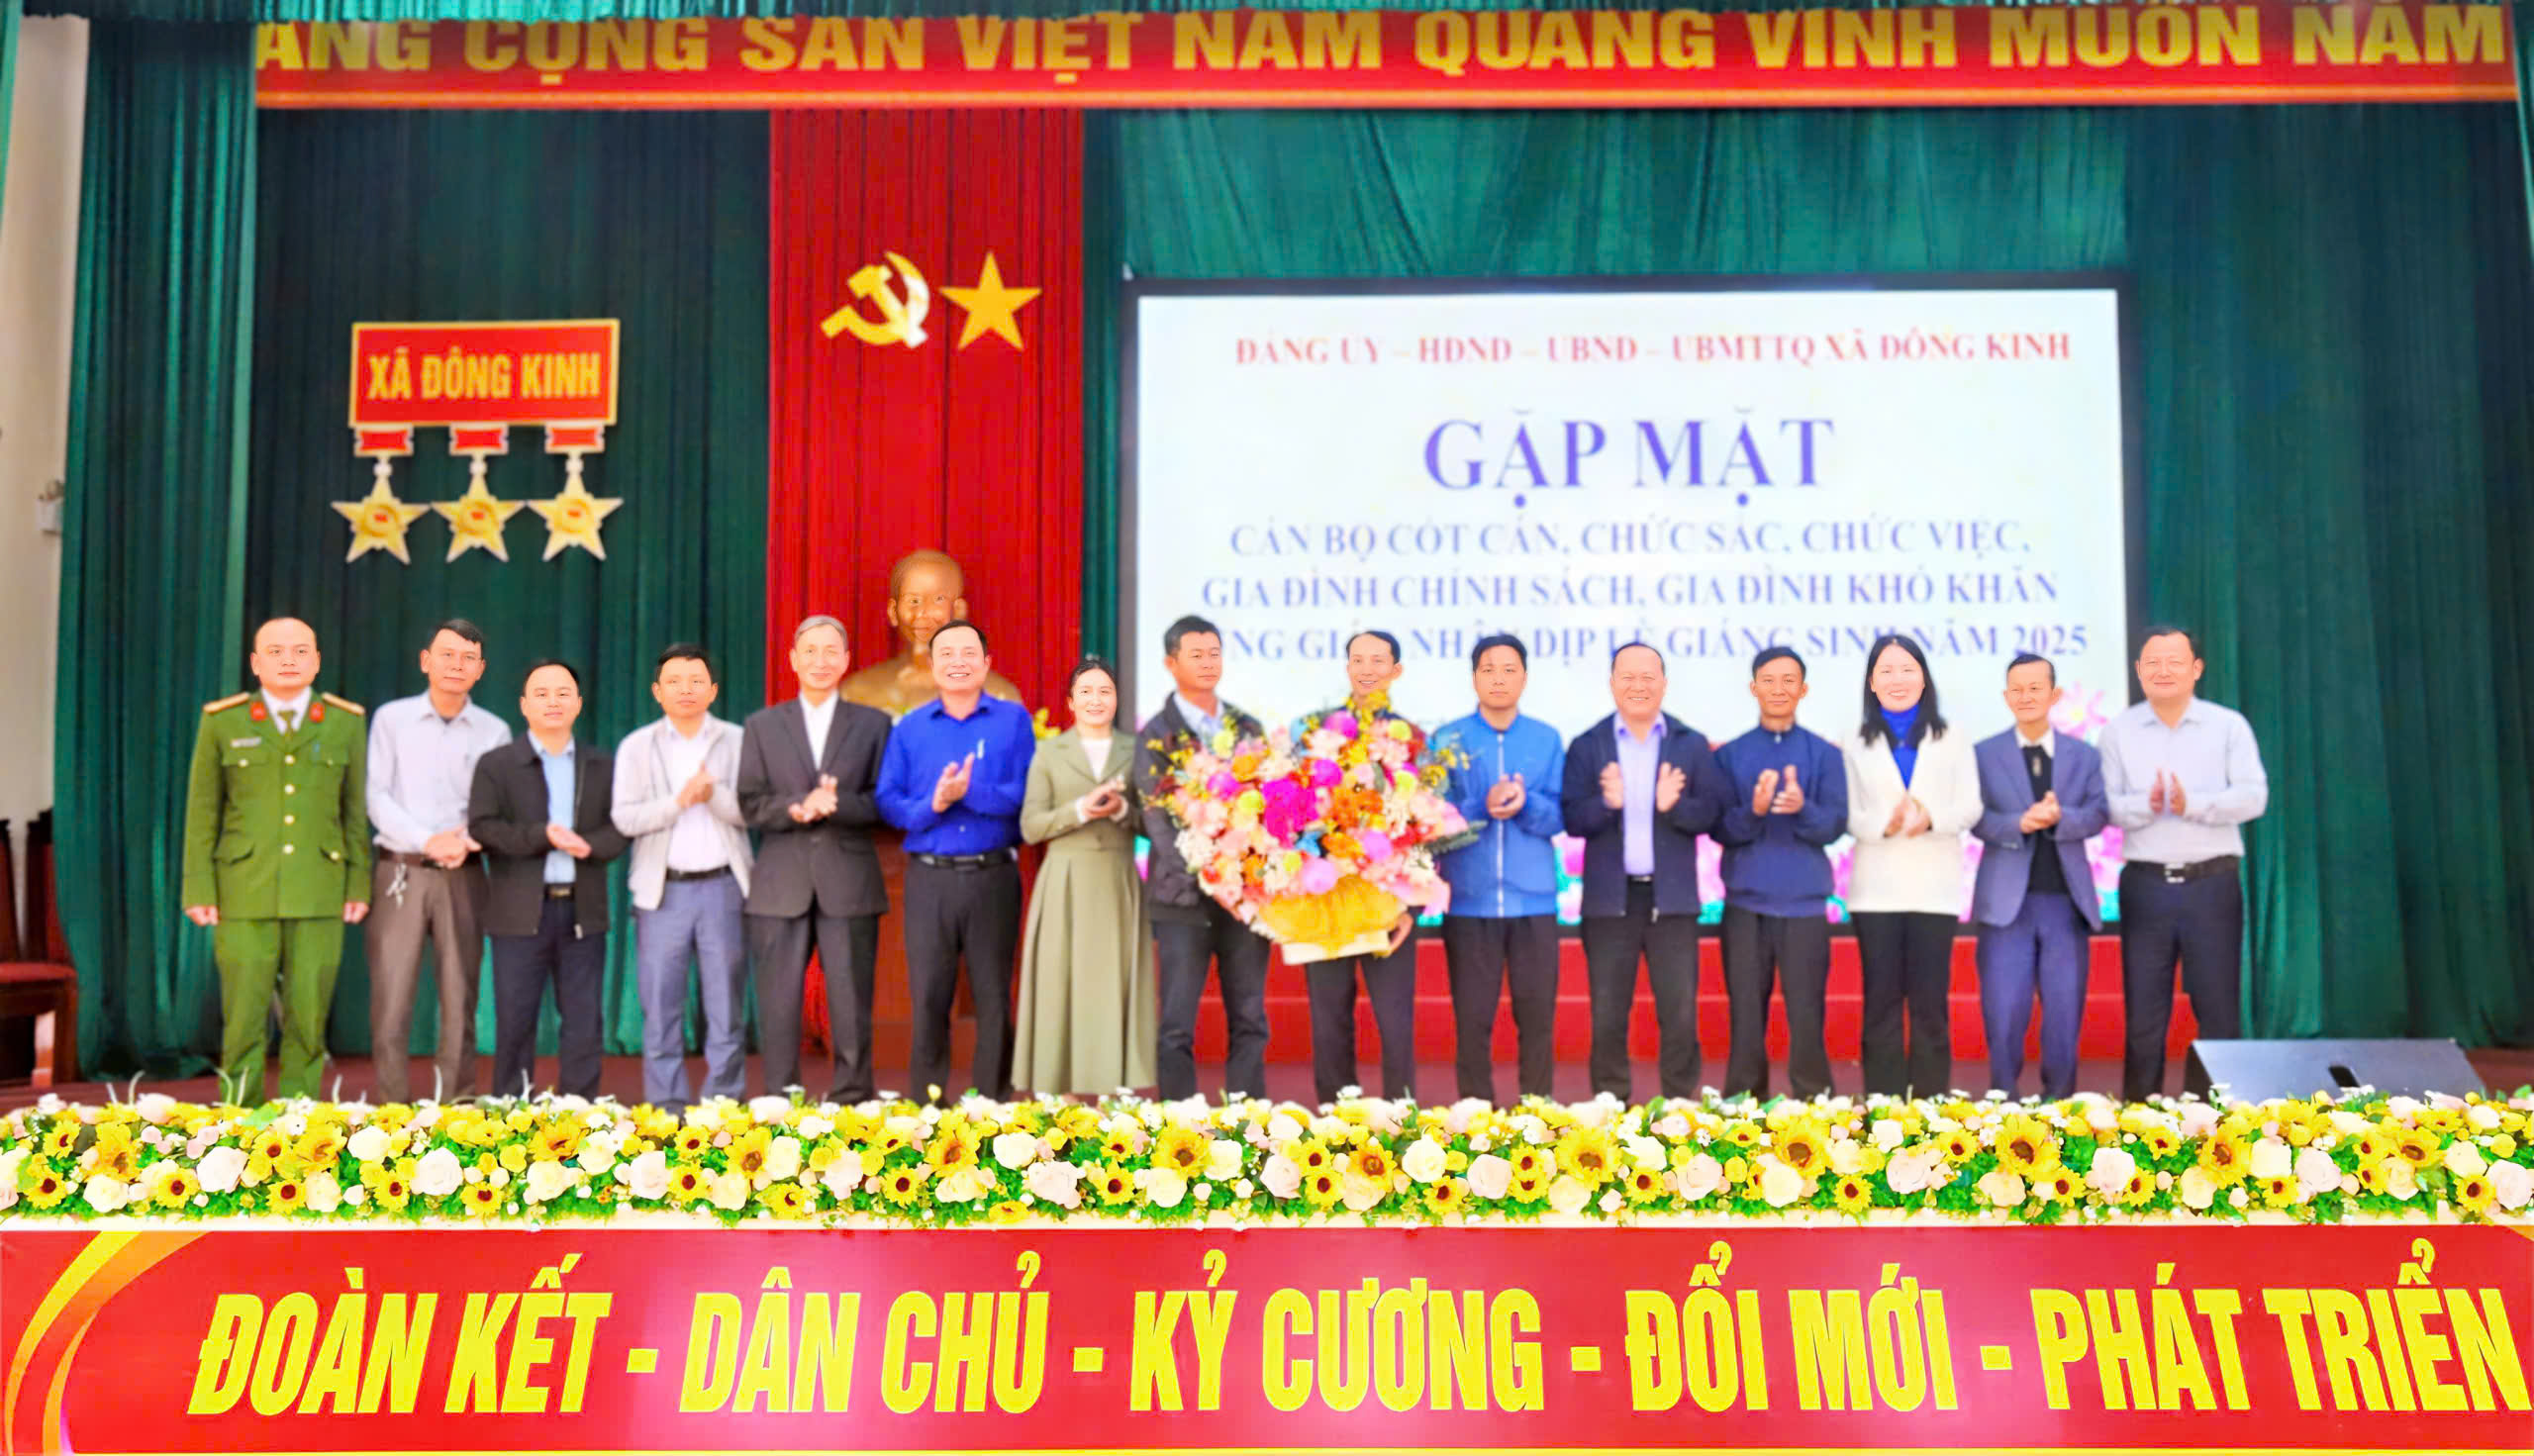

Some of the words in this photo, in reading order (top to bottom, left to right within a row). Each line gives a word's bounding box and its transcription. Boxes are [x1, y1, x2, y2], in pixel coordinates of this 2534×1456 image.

[1173, 10, 1381, 70] NAM
[1415, 9, 1715, 76] QUANG
[1746, 9, 1956, 68] VINH
[366, 345, 413, 400] XÃ
[421, 344, 513, 400] ĐÔNG
[521, 351, 602, 399] KINH
[1548, 336, 1638, 362] UBND
[1672, 334, 1816, 367] UBMTTQ
[1986, 333, 2071, 360] KINH
[1424, 407, 1608, 508] GẶP
[1633, 407, 1835, 507] MẶT
[1202, 575, 1271, 608] GIA
[1657, 574, 1726, 606] GIA
[1533, 628, 1597, 666] DỊP
[2011, 625, 2089, 657] 2025
[187, 1267, 439, 1416] ĐOÀN
[443, 1253, 613, 1414] KẾT
[679, 1267, 861, 1412] DÂN
[881, 1250, 1049, 1414] CHỦ
[1129, 1249, 1237, 1411] KỶ
[1262, 1277, 1544, 1412] CƯƠNG
[1624, 1240, 1769, 1412] ĐỔI
[1788, 1262, 1958, 1412] MỚI
[2029, 1262, 2251, 1410] PHÁT
[2262, 1237, 2532, 1412] TRIỂN
